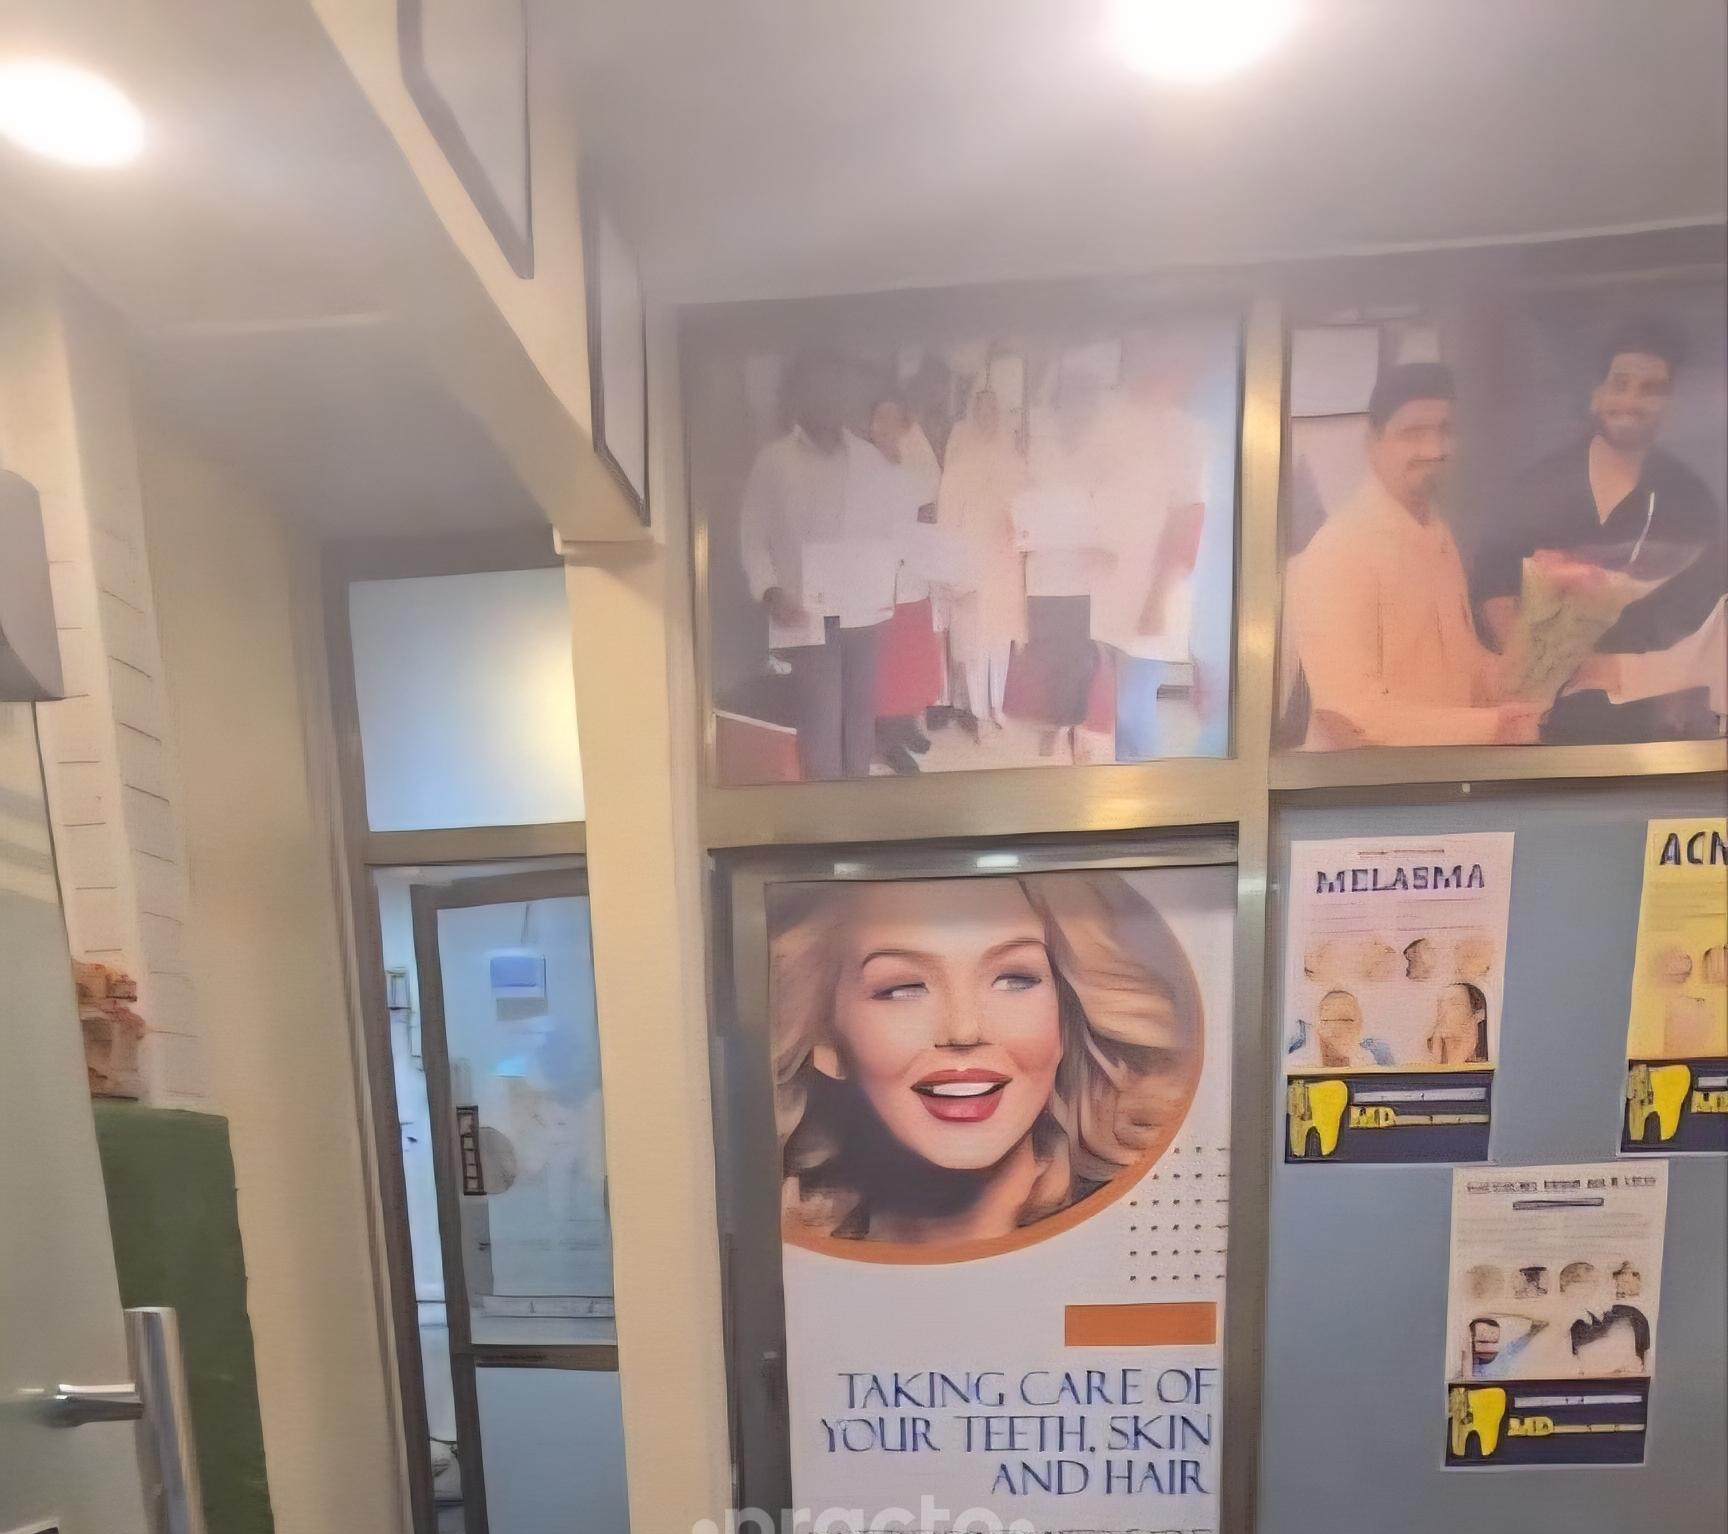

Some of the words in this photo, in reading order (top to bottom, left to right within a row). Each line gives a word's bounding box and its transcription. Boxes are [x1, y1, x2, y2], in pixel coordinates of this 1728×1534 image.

[838, 1371, 1006, 1409] TAKING
[1019, 1369, 1143, 1407] CARE
[1156, 1367, 1217, 1406] OF
[821, 1416, 941, 1453] YOUR
[1106, 1414, 1212, 1451] SKIN
[991, 1459, 1090, 1496] AND
[1105, 1458, 1211, 1495] HAIR
